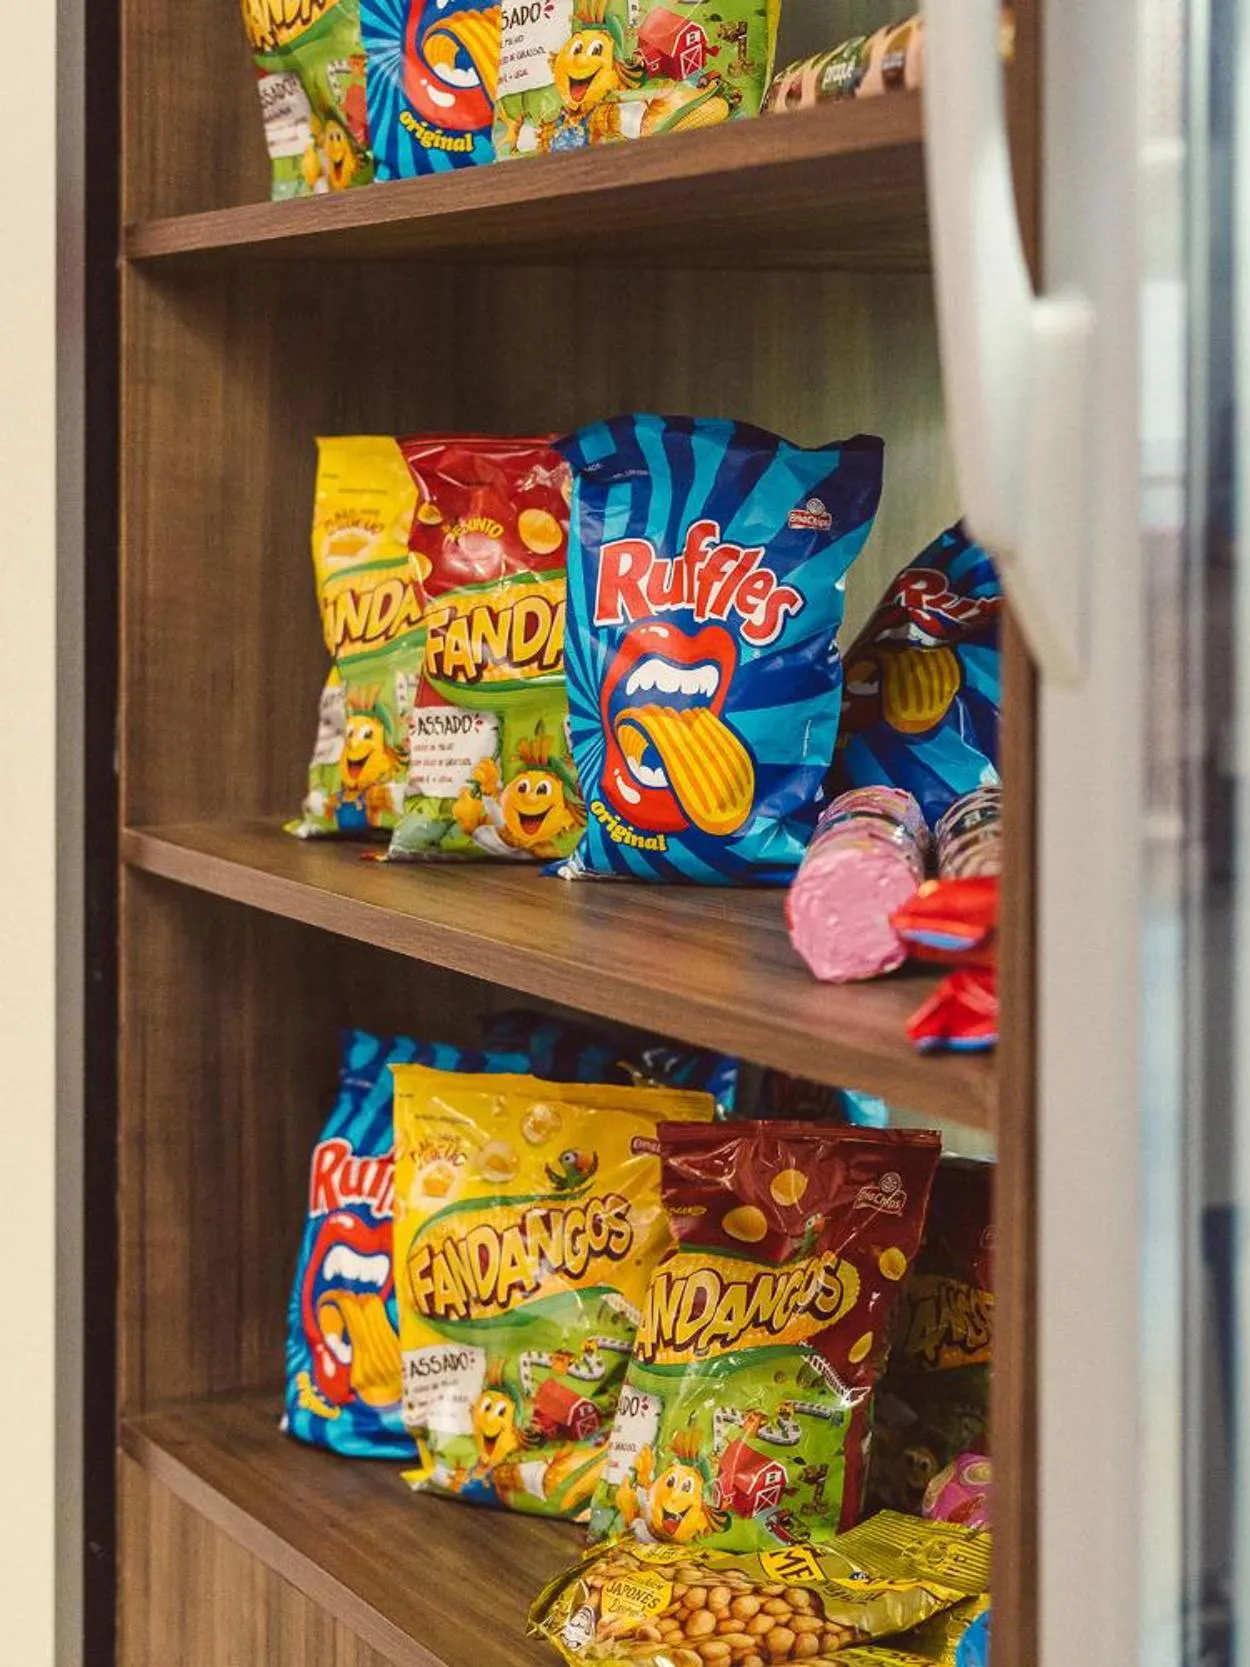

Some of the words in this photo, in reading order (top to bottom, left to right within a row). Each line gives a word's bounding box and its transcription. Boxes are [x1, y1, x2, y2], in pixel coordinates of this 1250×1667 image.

[400, 111, 475, 152] original
[594, 519, 804, 646] Ruffles
[417, 714, 473, 736] ASSADO
[591, 800, 668, 852] original
[408, 1193, 633, 1321] FANDANGOS
